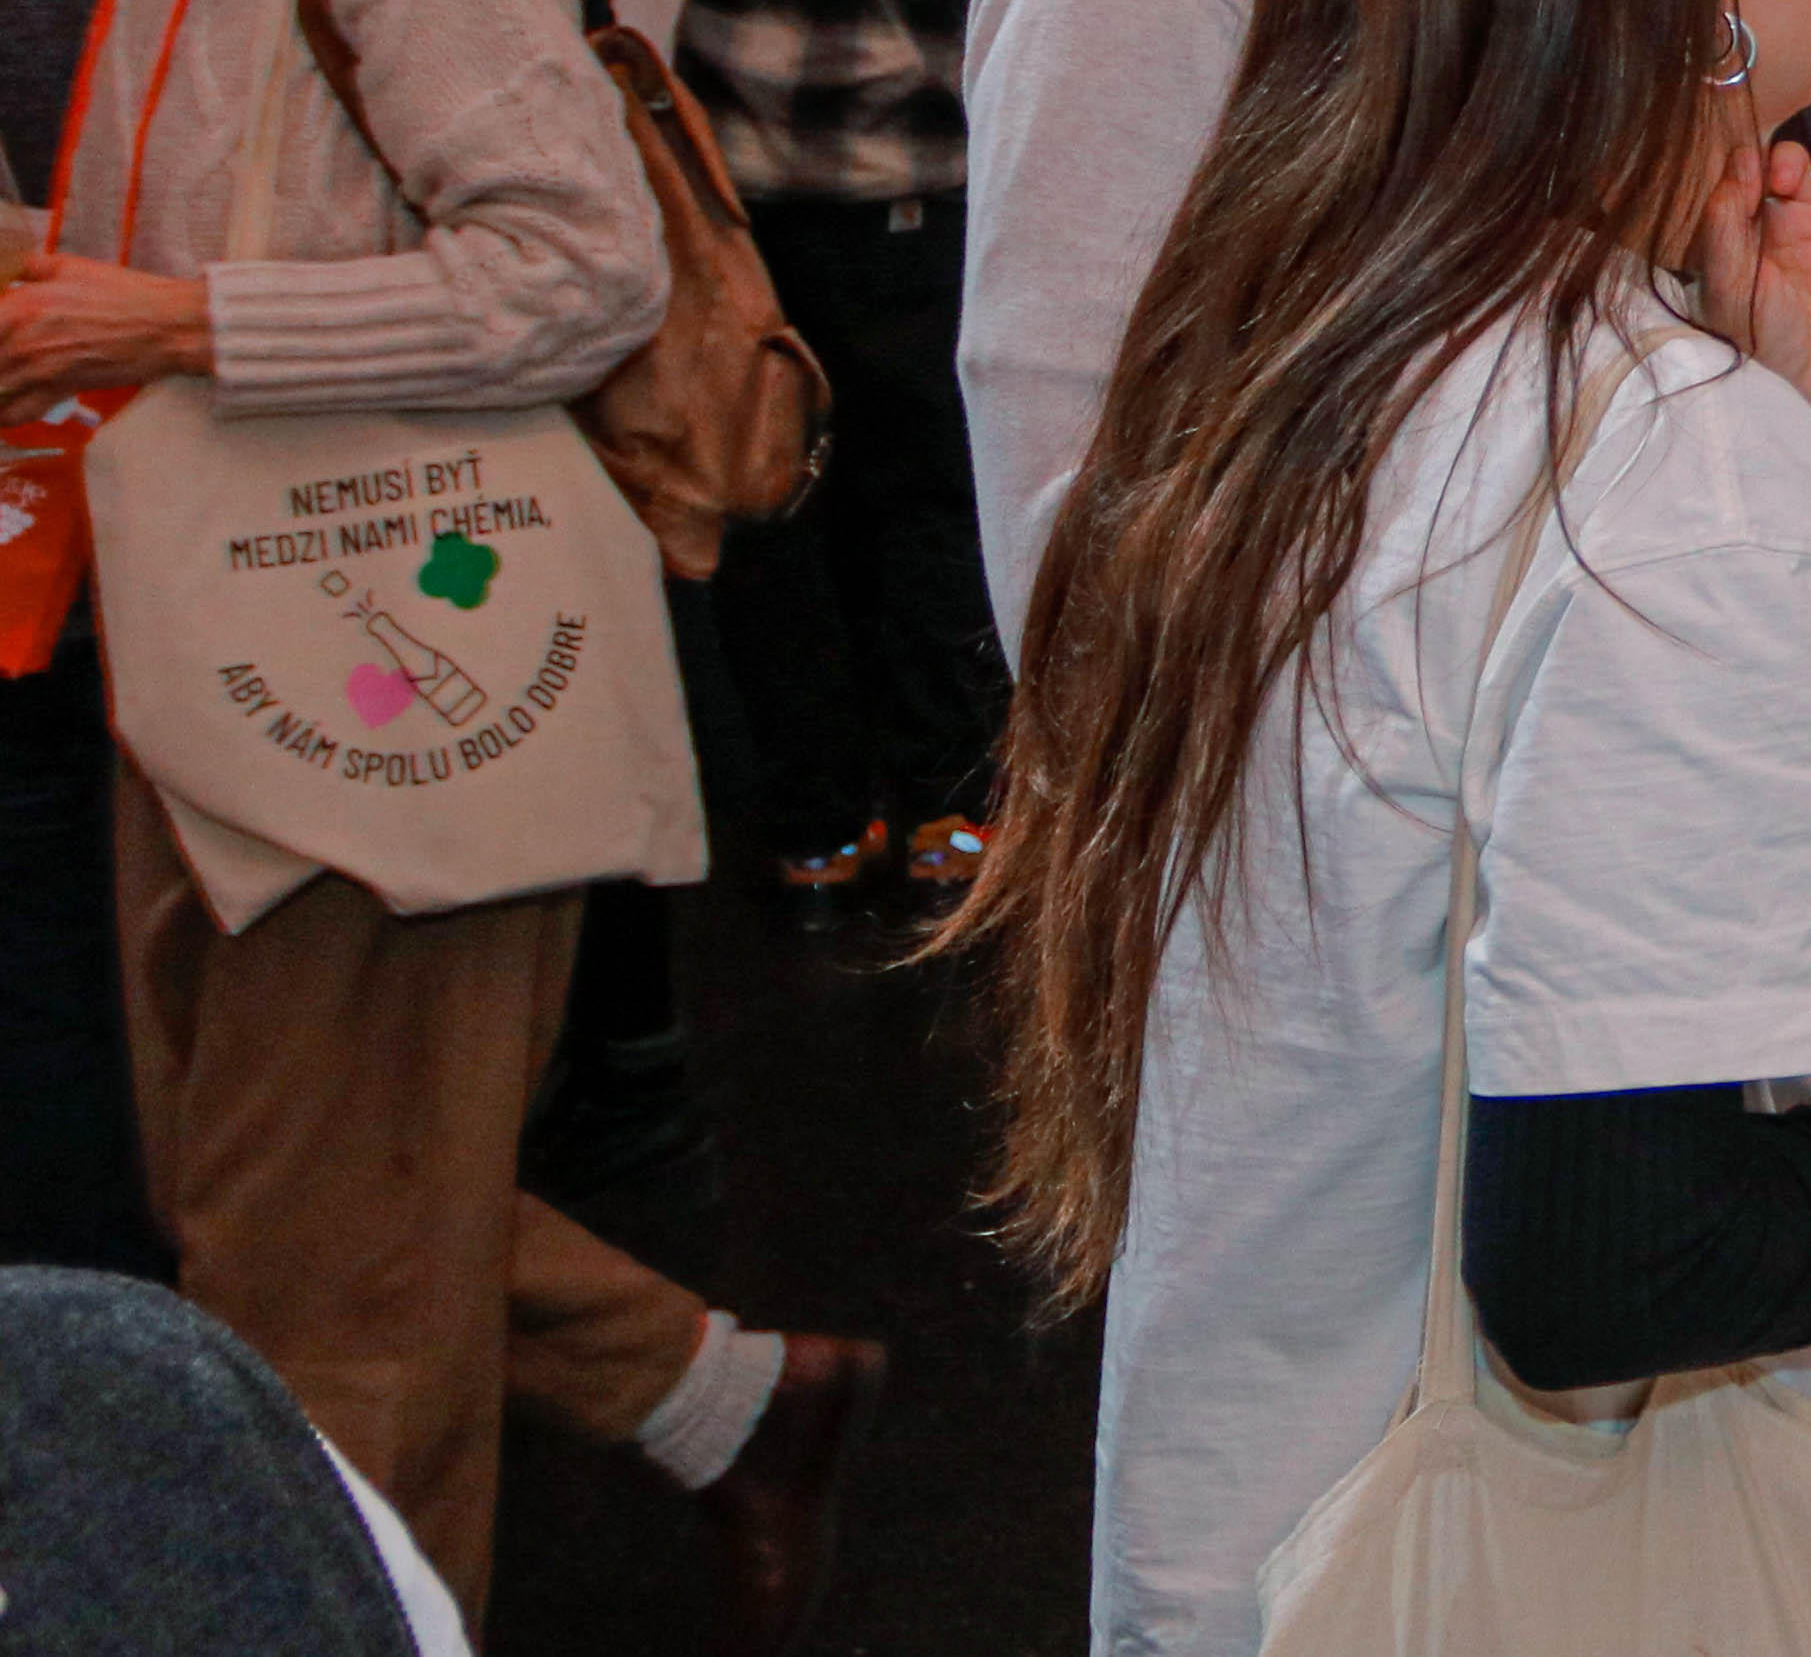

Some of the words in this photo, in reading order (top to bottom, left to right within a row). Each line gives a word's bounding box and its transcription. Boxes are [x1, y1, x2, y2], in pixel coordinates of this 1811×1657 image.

[288, 459, 415, 518] NEMUSÍ
[425, 449, 484, 496] BYŤ
[229, 530, 328, 570] MEDZI
[339, 513, 418, 557] NAMI
[218, 662, 281, 718] ABY
[265, 711, 339, 770] NÁM
[344, 748, 452, 787] SPOLU
[459, 705, 537, 771] BOLO
[526, 610, 588, 711] DOBRE
